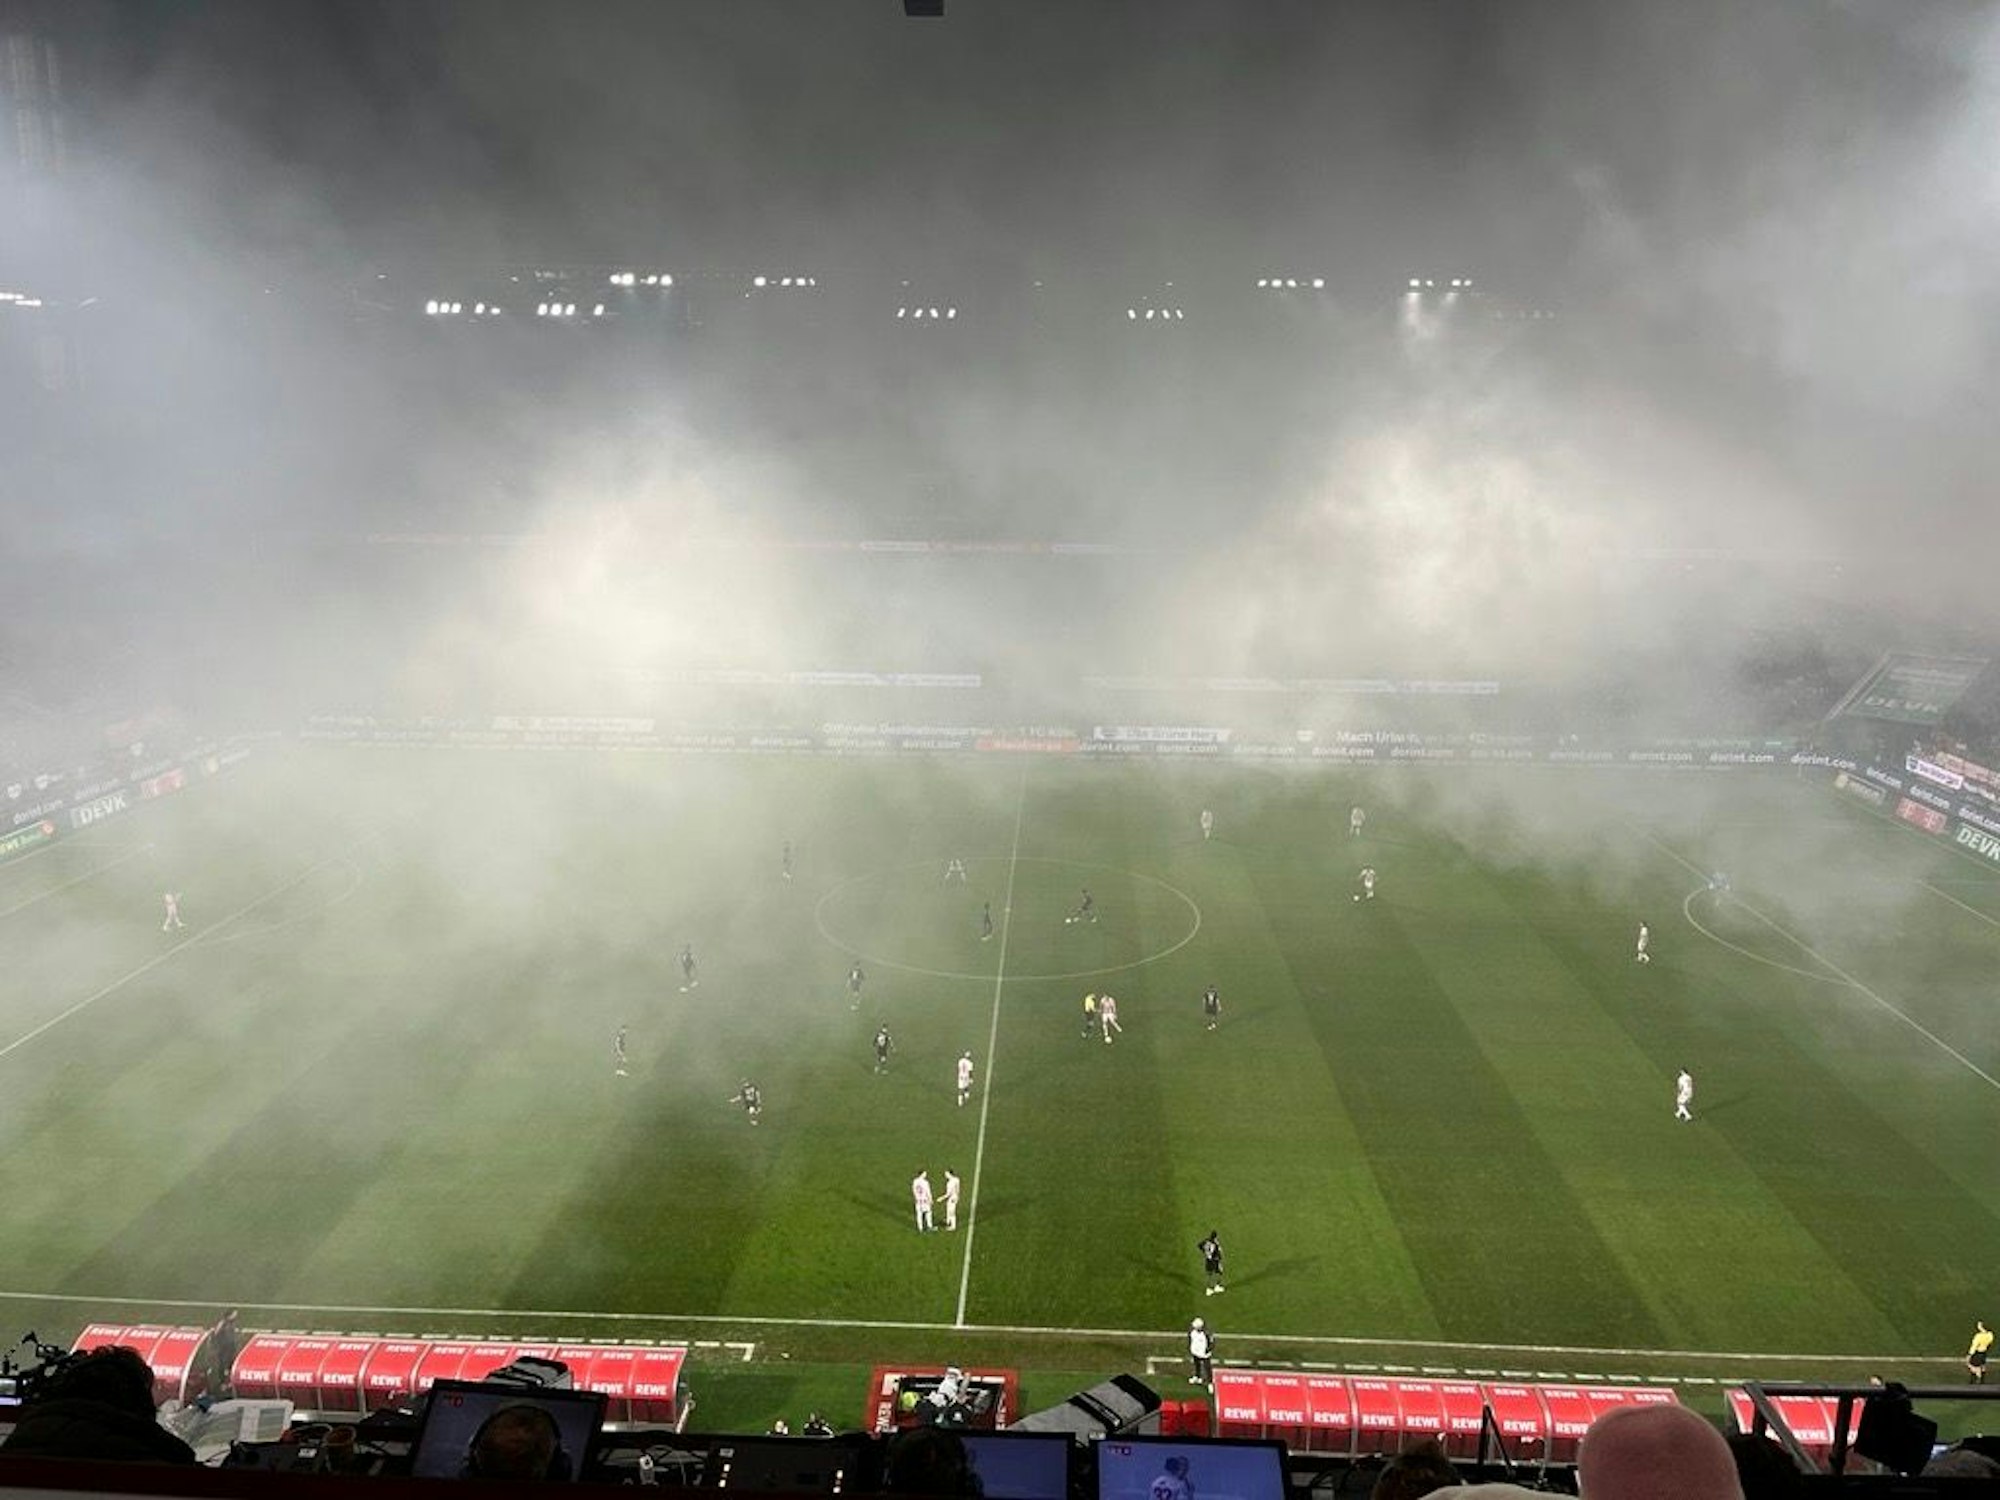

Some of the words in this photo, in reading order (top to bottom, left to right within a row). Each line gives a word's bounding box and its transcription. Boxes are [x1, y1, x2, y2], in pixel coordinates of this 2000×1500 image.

[1709, 752, 1774, 763] dorint.com
[1790, 752, 1856, 770] dorint.com
[79, 794, 127, 824] DEVK
[92, 1327, 121, 1337] REWE
[130, 1329, 161, 1339] REWE
[168, 1331, 200, 1341] REWE
[256, 1339, 288, 1348] REWE
[298, 1341, 329, 1350] REWE
[339, 1343, 370, 1352] REWE
[387, 1344, 418, 1353] REWE
[433, 1346, 466, 1355] REWE
[560, 1350, 593, 1359] REWE
[601, 1351, 633, 1360] REWE
[644, 1352, 676, 1361] REWE
[240, 1370, 270, 1382] REWE
[281, 1372, 314, 1384] REWE
[323, 1373, 355, 1385] REWE
[370, 1375, 402, 1387] REWE
[634, 1384, 667, 1395] REWE
[1221, 1375, 1254, 1384] REWE
[1265, 1377, 1298, 1386] REWE
[1308, 1379, 1342, 1388] REWE
[1354, 1381, 1388, 1390] REWE
[1399, 1383, 1433, 1392] REWE
[1442, 1385, 1477, 1394] REWE
[1495, 1387, 1528, 1397] REWE
[1545, 1390, 1580, 1399] REWE
[1589, 1391, 1624, 1401] REWE
[1634, 1393, 1671, 1402] REWE
[1224, 1407, 1258, 1420] REWE
[1269, 1409, 1303, 1422] REWE
[1313, 1412, 1347, 1425] REWE
[1361, 1414, 1395, 1427] REWE
[1406, 1416, 1440, 1429] REWE
[1502, 1420, 1537, 1432] REWE
